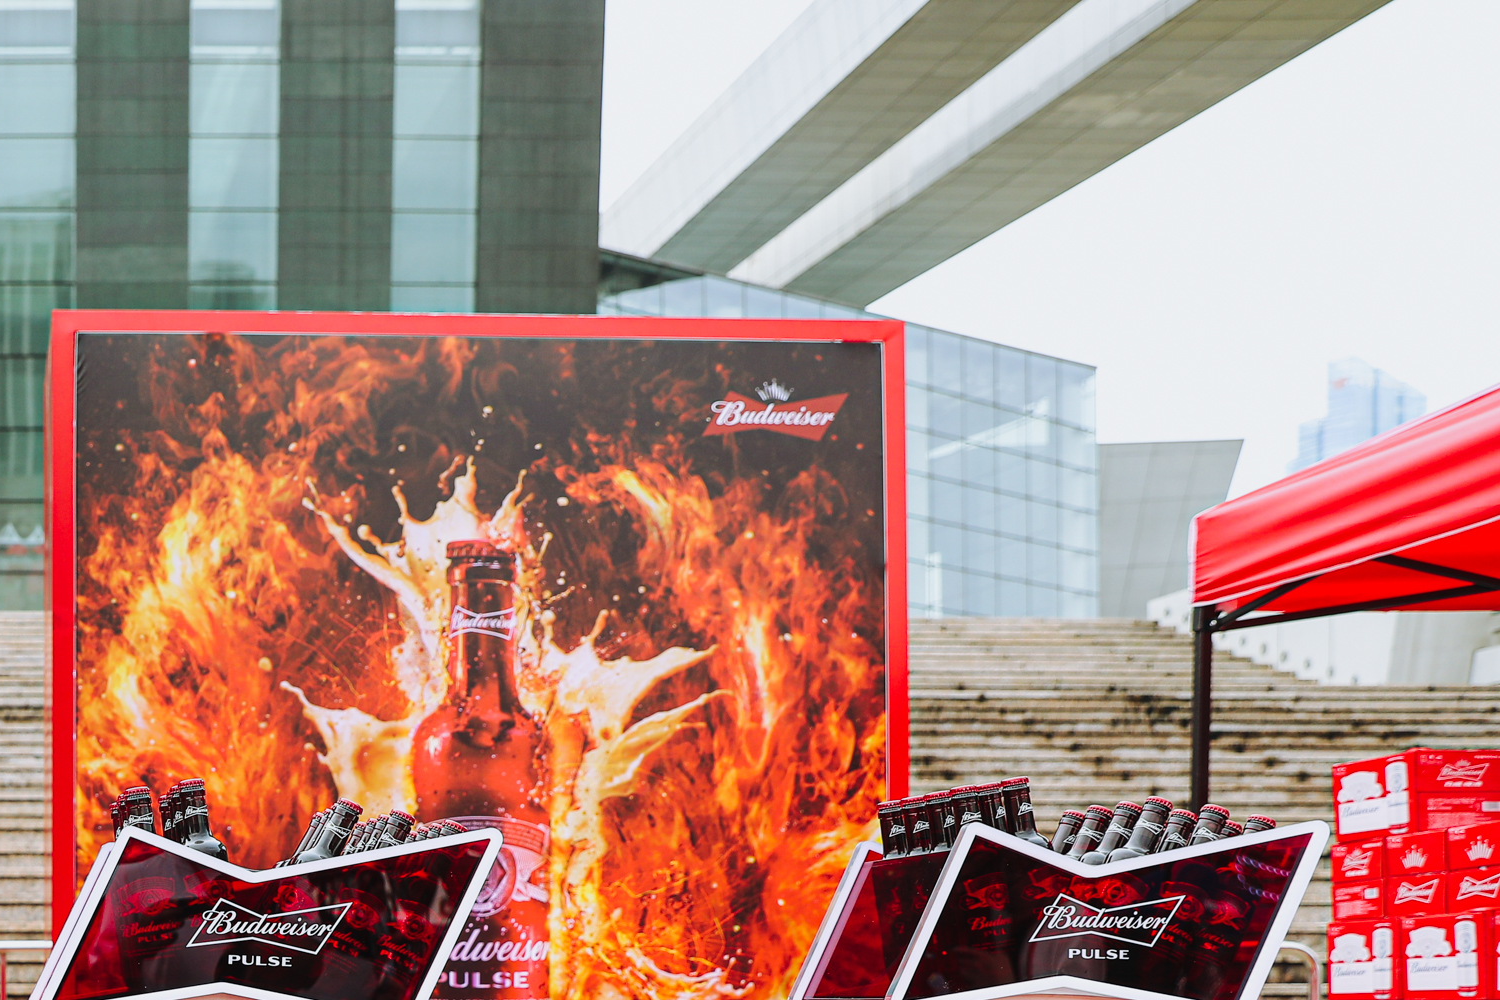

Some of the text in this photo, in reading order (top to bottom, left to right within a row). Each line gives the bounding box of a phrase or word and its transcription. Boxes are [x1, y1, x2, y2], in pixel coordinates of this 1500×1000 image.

[711, 400, 835, 426] Budweiser
[201, 909, 333, 937] Budweiser
[1043, 905, 1168, 930] Budweiser
[227, 954, 292, 967] PULSE
[1068, 948, 1130, 960] PULSE
